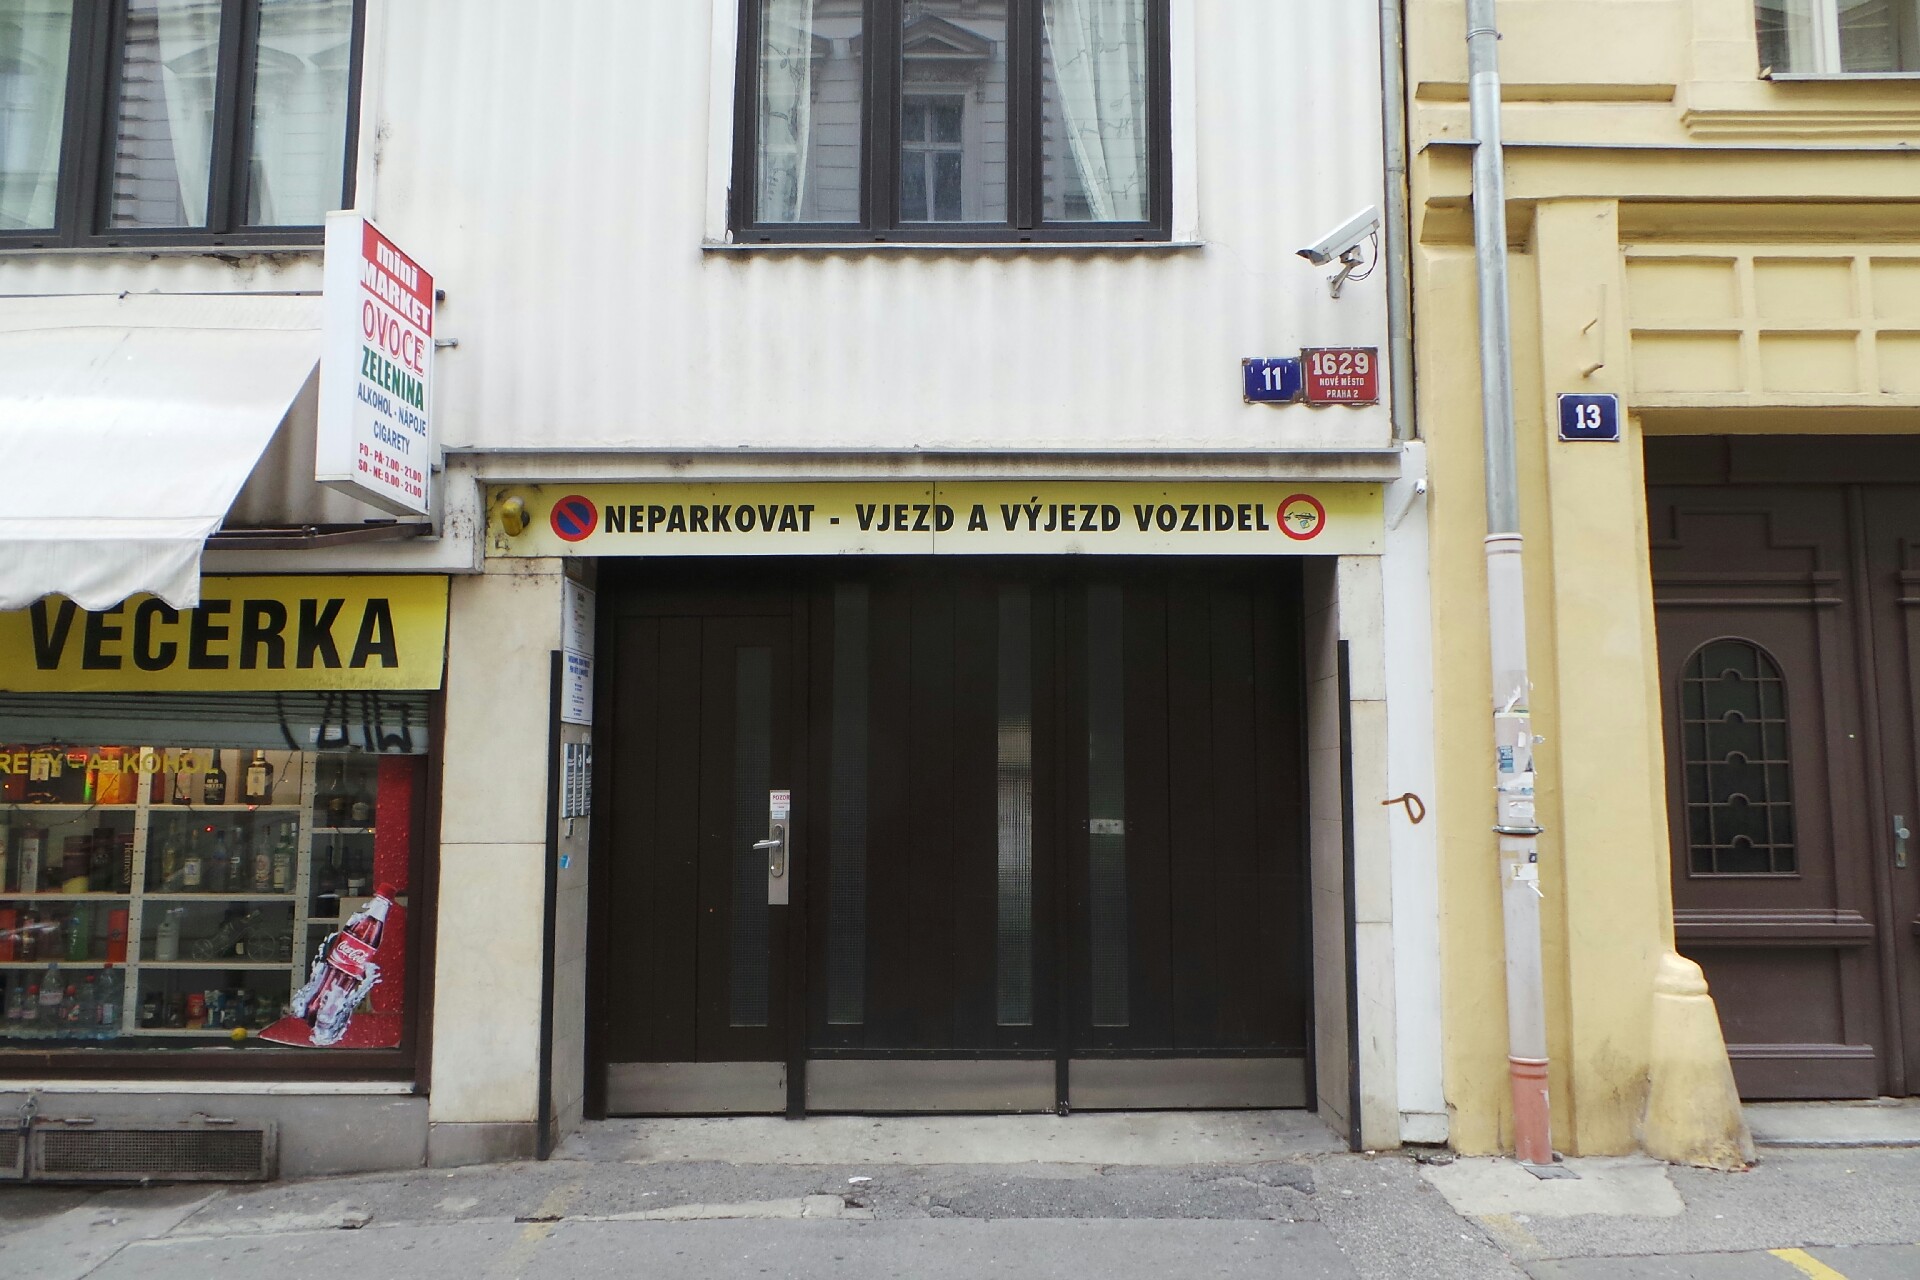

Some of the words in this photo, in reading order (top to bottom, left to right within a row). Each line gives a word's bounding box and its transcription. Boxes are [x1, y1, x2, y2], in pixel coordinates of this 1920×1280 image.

[376, 240, 418, 293] mini
[360, 258, 431, 332] MARKET
[363, 299, 425, 377] OVOCE
[361, 344, 425, 412] ZELENINA
[1262, 367, 1282, 391] 11
[1312, 352, 1370, 376] 1629
[1319, 374, 1339, 386] NOVÉ
[1341, 374, 1365, 386] MĚSTO
[357, 382, 393, 419] ALKOHOL
[398, 406, 427, 437] NÁPOJE
[1326, 389, 1352, 399] PRAHA
[1353, 389, 1359, 398] 2
[1575, 404, 1602, 429] 13
[373, 420, 411, 456] CIGARETY
[358, 458, 368, 473] SO
[384, 471, 400, 488] 9.00
[404, 481, 422, 499] 21.00
[359, 442, 369, 457] PO
[385, 455, 400, 473] 7.00
[404, 465, 422, 483] 21.00
[605, 503, 816, 533] NEPARKOVAT
[830, 517, 840, 525] -
[855, 503, 956, 532] VJEZD
[967, 504, 989, 532] A
[1000, 496, 1122, 532] VÝJEZD
[1133, 503, 1270, 532] VOZIDEL
[87, 752, 219, 775] ALKOHOL
